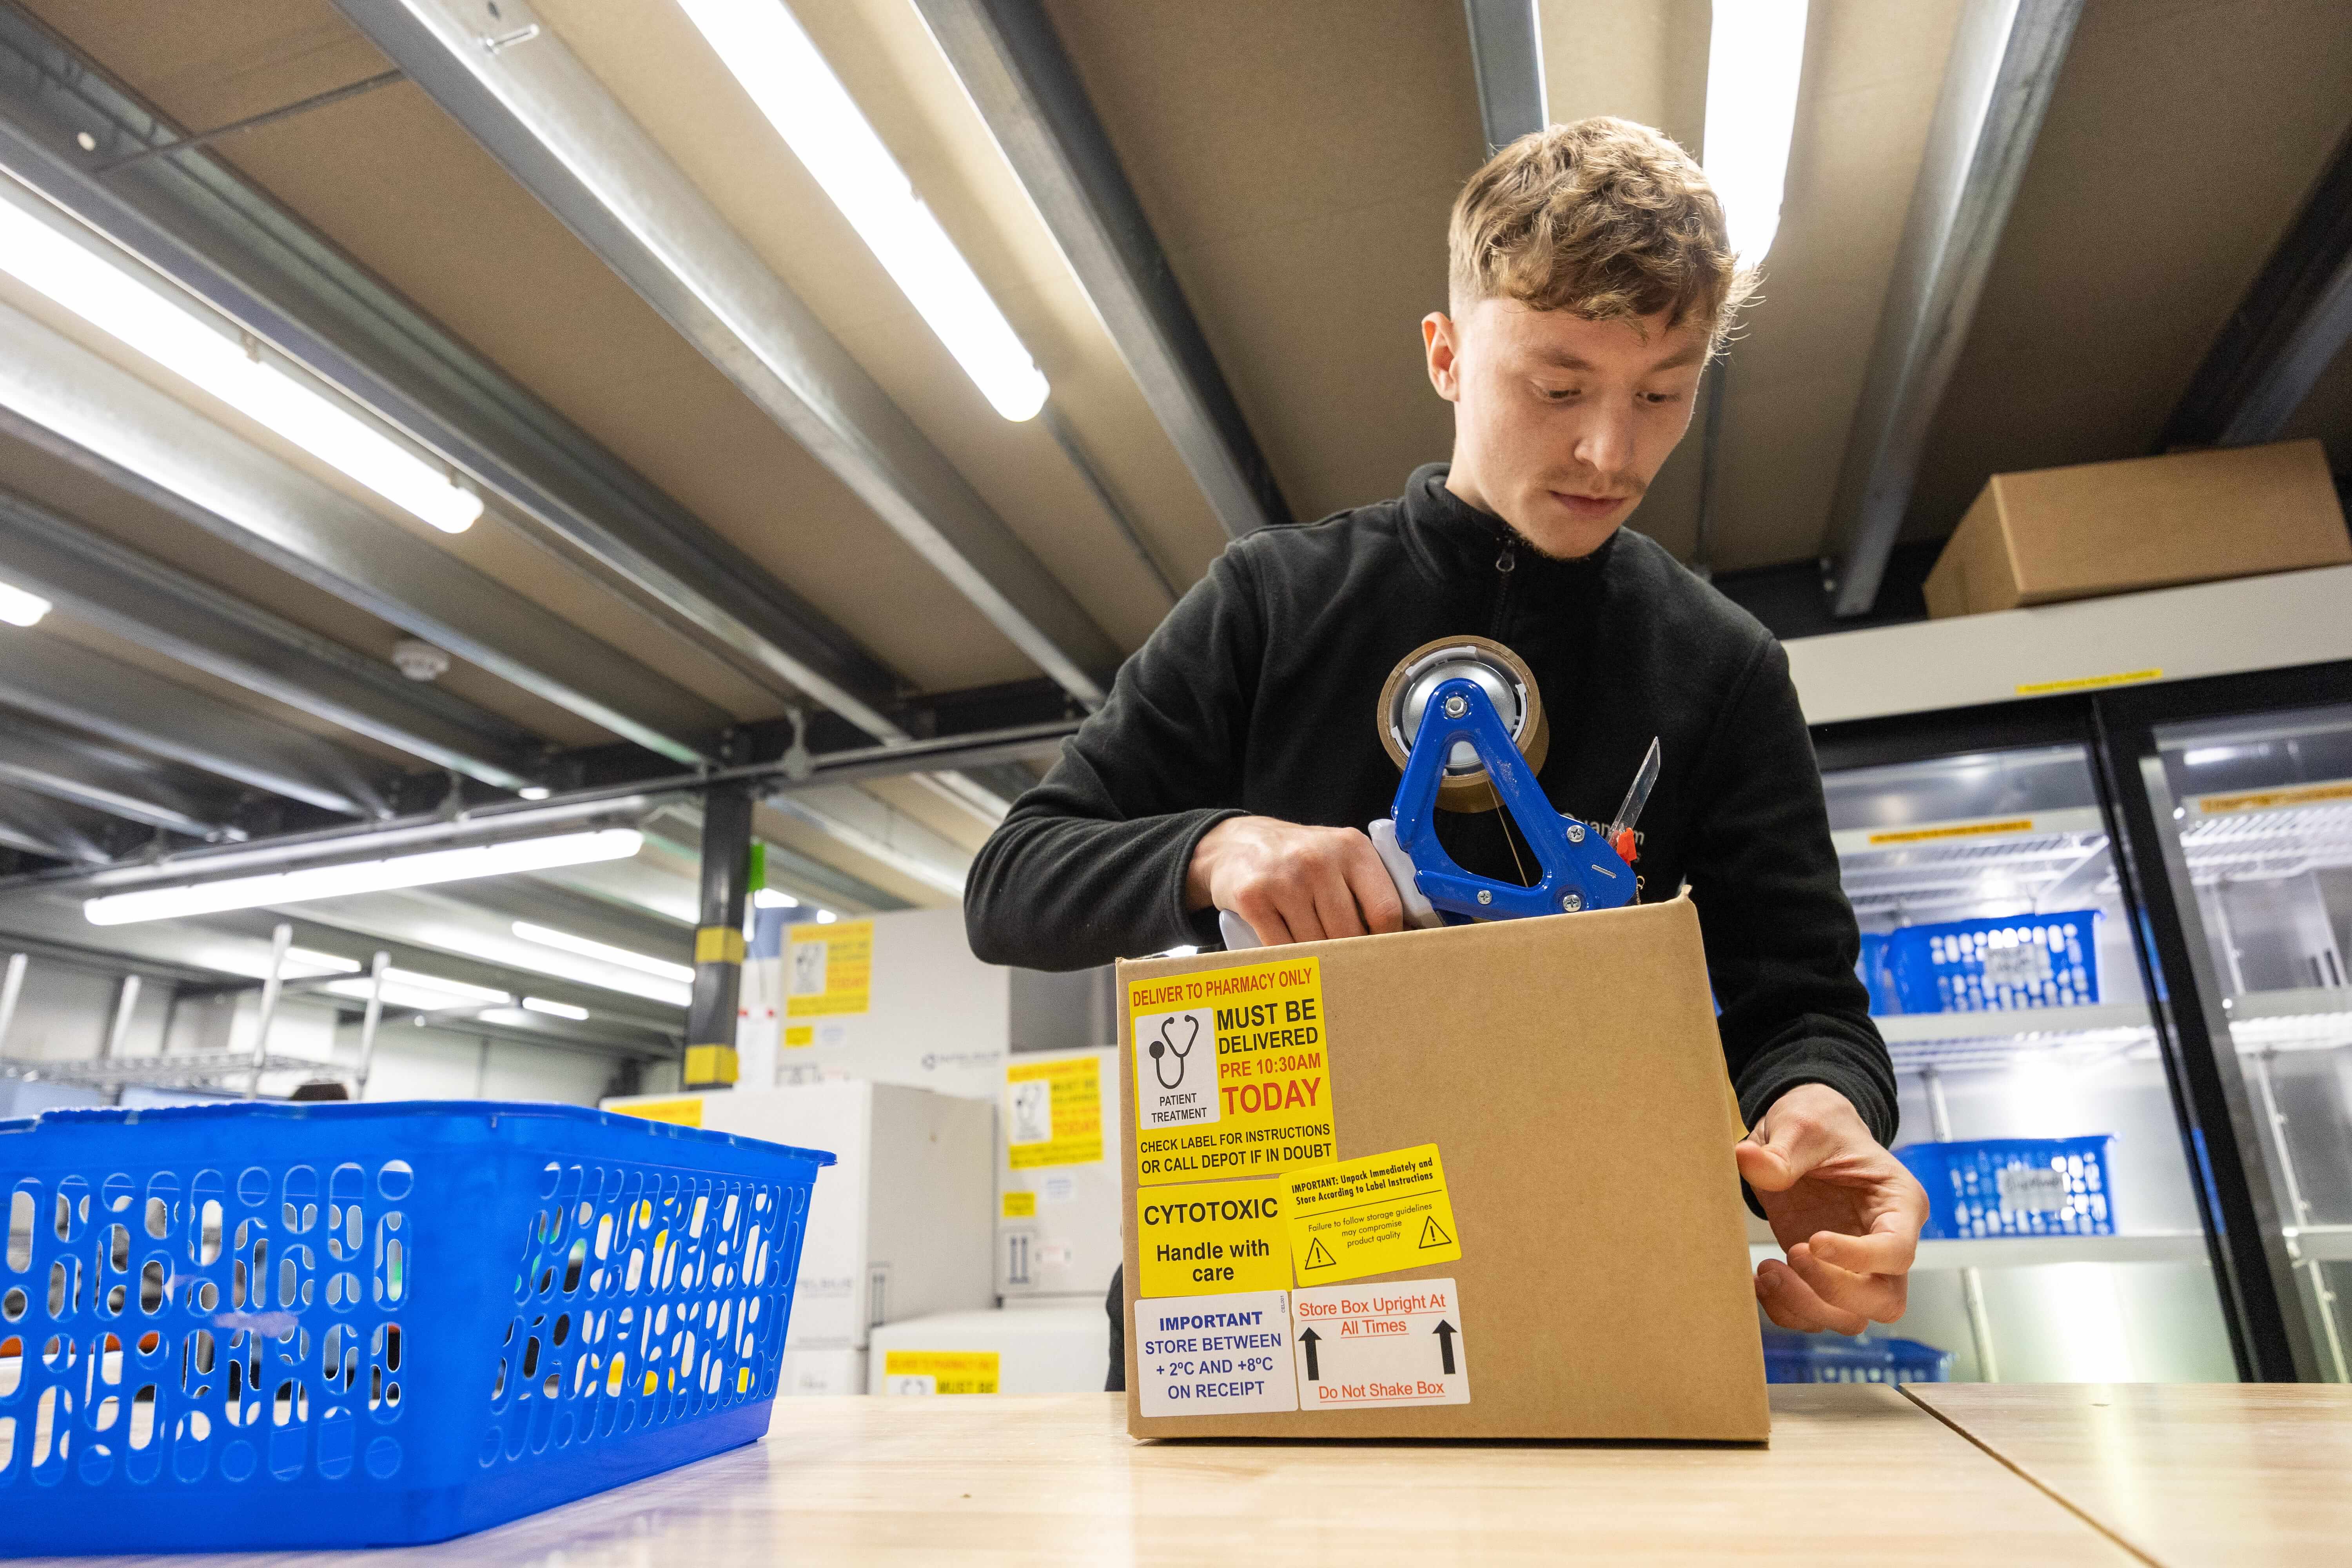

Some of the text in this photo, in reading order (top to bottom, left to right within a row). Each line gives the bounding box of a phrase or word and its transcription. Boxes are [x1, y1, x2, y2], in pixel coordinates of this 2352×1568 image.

[1133, 968, 1312, 1007] DELIVER TO PHARMACY ONLY
[1217, 998, 1316, 1031] MUST BE
[1219, 1027, 1318, 1054] DELIVERED
[1220, 1053, 1321, 1078] PRE 10:30AM
[1160, 1093, 1197, 1106] PATIENT
[1222, 1077, 1321, 1114] TODAY
[1151, 1108, 1207, 1123] TREATMENT
[1141, 1123, 1330, 1153] CHECK LABEL FOR INSTRUCTIONS
[1142, 1143, 1332, 1173] OR CALL DEPOT IF IN DOUBT
[1292, 1157, 1433, 1194] IMPORTANT: Unpack Immediately and
[1296, 1196, 1316, 1205] Store
[1319, 1188, 1354, 1201] According
[1367, 1180, 1386, 1191] Label
[1388, 1172, 1433, 1187] Instructions
[1144, 1198, 1278, 1225] CYTOTOXIC
[1308, 1223, 1332, 1232] Failure
[1343, 1216, 1364, 1225] follow
[1367, 1211, 1394, 1221] storage
[1396, 1203, 1432, 1216] guidelines
[1342, 1221, 1402, 1237] may compromise
[1347, 1232, 1401, 1248] product quality
[1157, 1239, 1269, 1261] Handle with
[1193, 1267, 1234, 1282] care
[1299, 1294, 1446, 1316] Store Box Upright At
[1160, 1311, 1262, 1331] IMPORTANT
[1341, 1319, 1406, 1336] All Times
[1145, 1333, 1281, 1354] STORE BETWEEN
[1199, 1360, 1232, 1374] AND
[1168, 1381, 1264, 1399] ON RECEIPT
[1319, 1381, 1445, 1399] Do Not Shake Box
